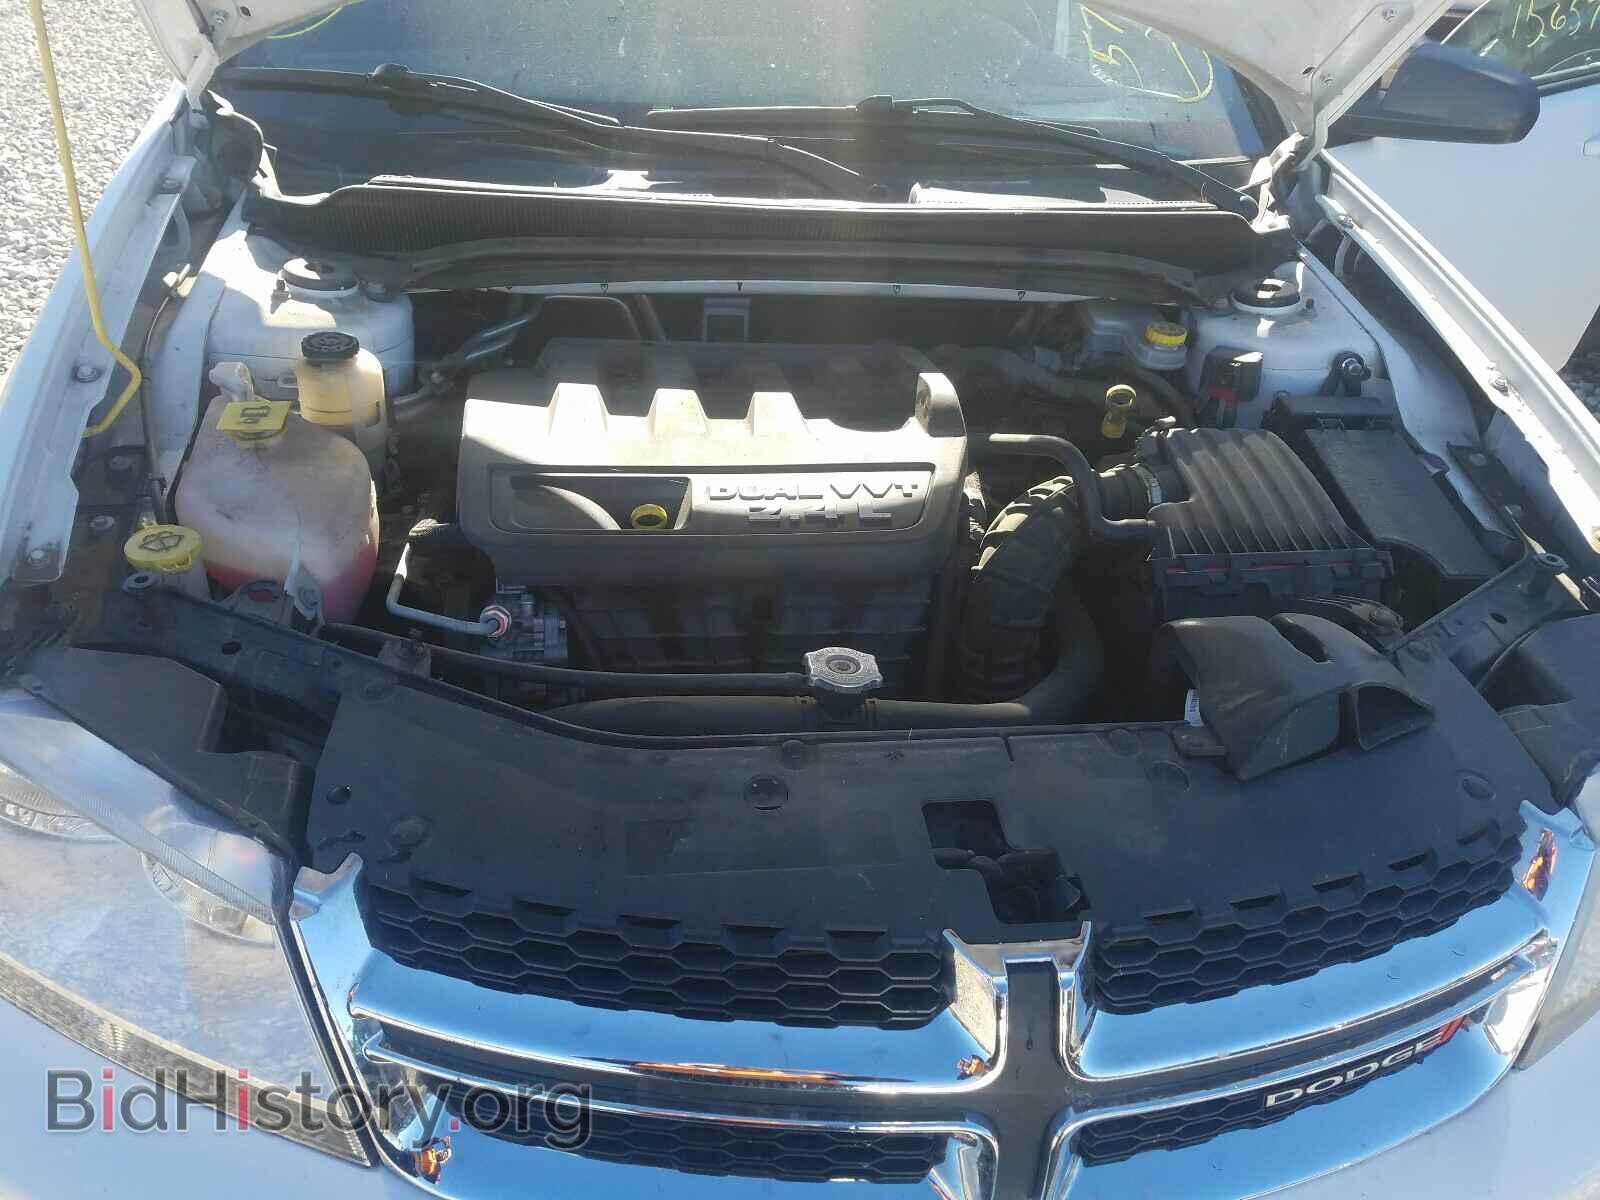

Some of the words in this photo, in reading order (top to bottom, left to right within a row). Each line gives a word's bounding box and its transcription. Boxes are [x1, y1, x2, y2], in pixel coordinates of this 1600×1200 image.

[706, 483, 824, 501] DUAL
[829, 482, 919, 499] VVT
[747, 503, 893, 528] 2.4L
[1265, 1033, 1440, 1107] DODGE
